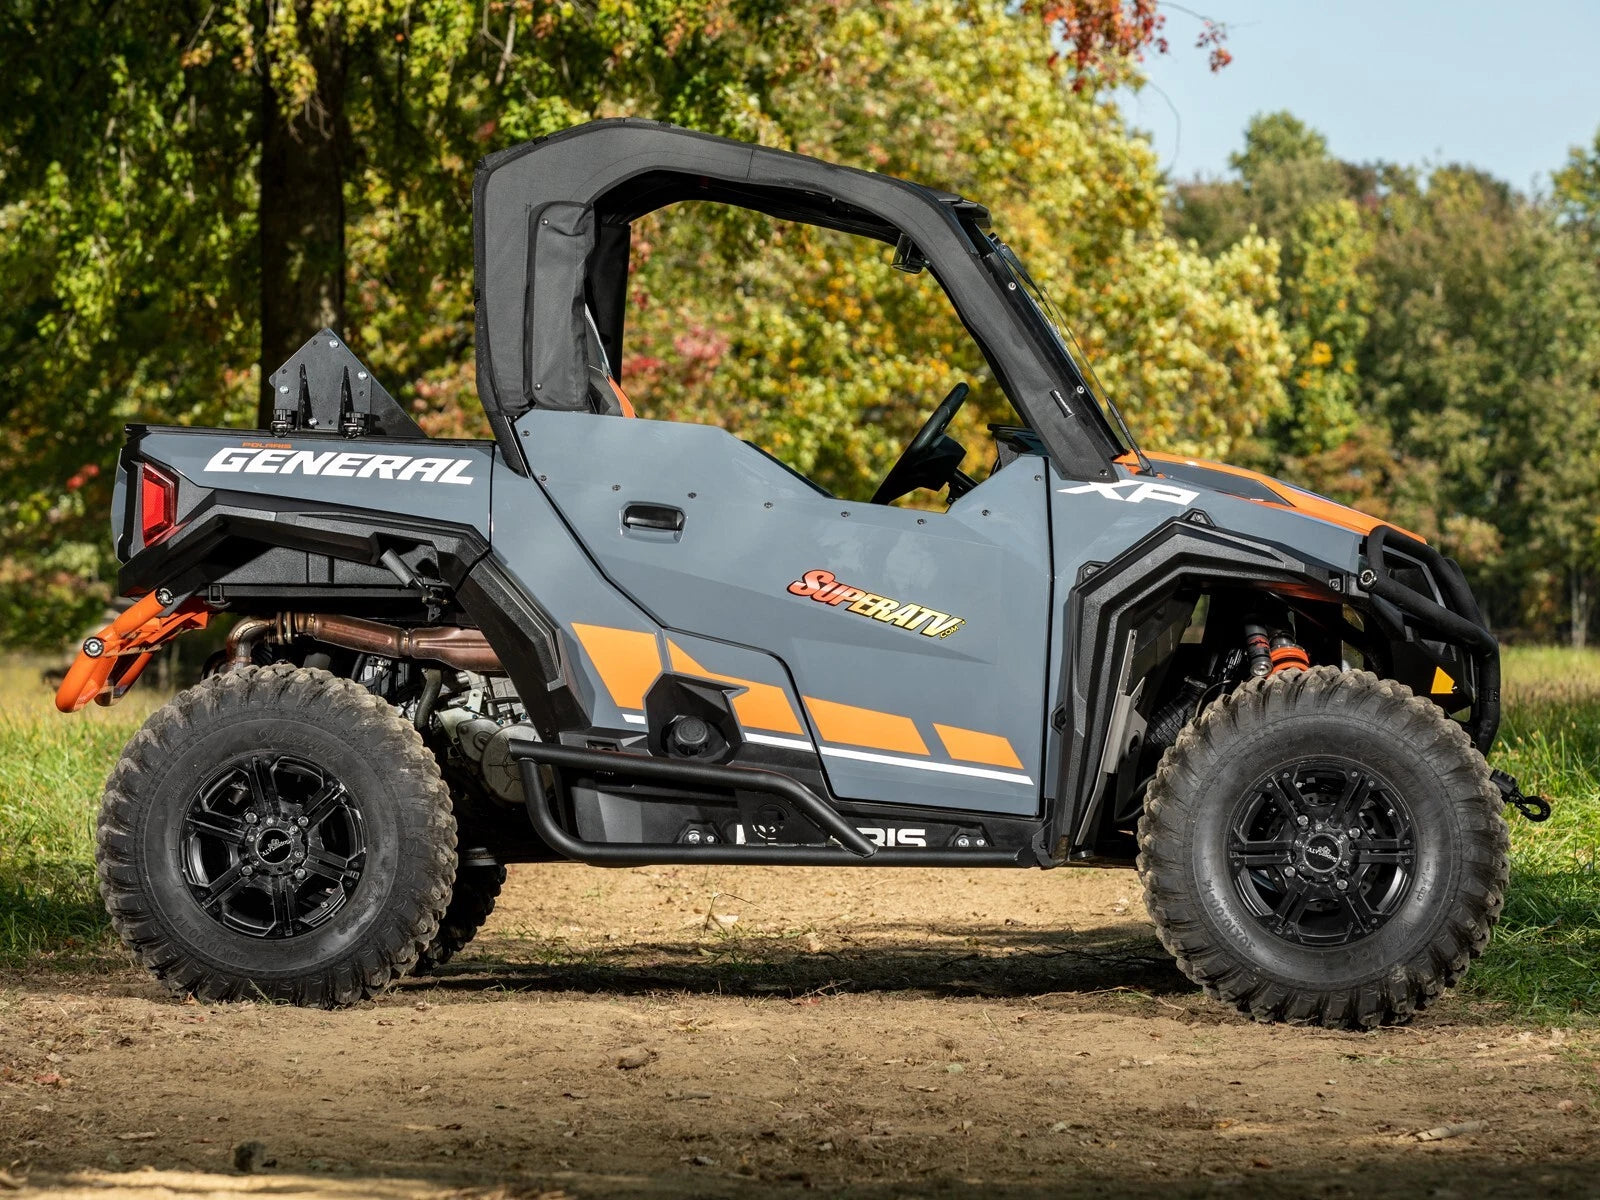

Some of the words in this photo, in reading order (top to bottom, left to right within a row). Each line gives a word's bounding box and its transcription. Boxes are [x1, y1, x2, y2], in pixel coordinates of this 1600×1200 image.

[241, 441, 292, 449] POLARIS
[203, 447, 474, 485] GENERAL
[1056, 479, 1200, 506] XP
